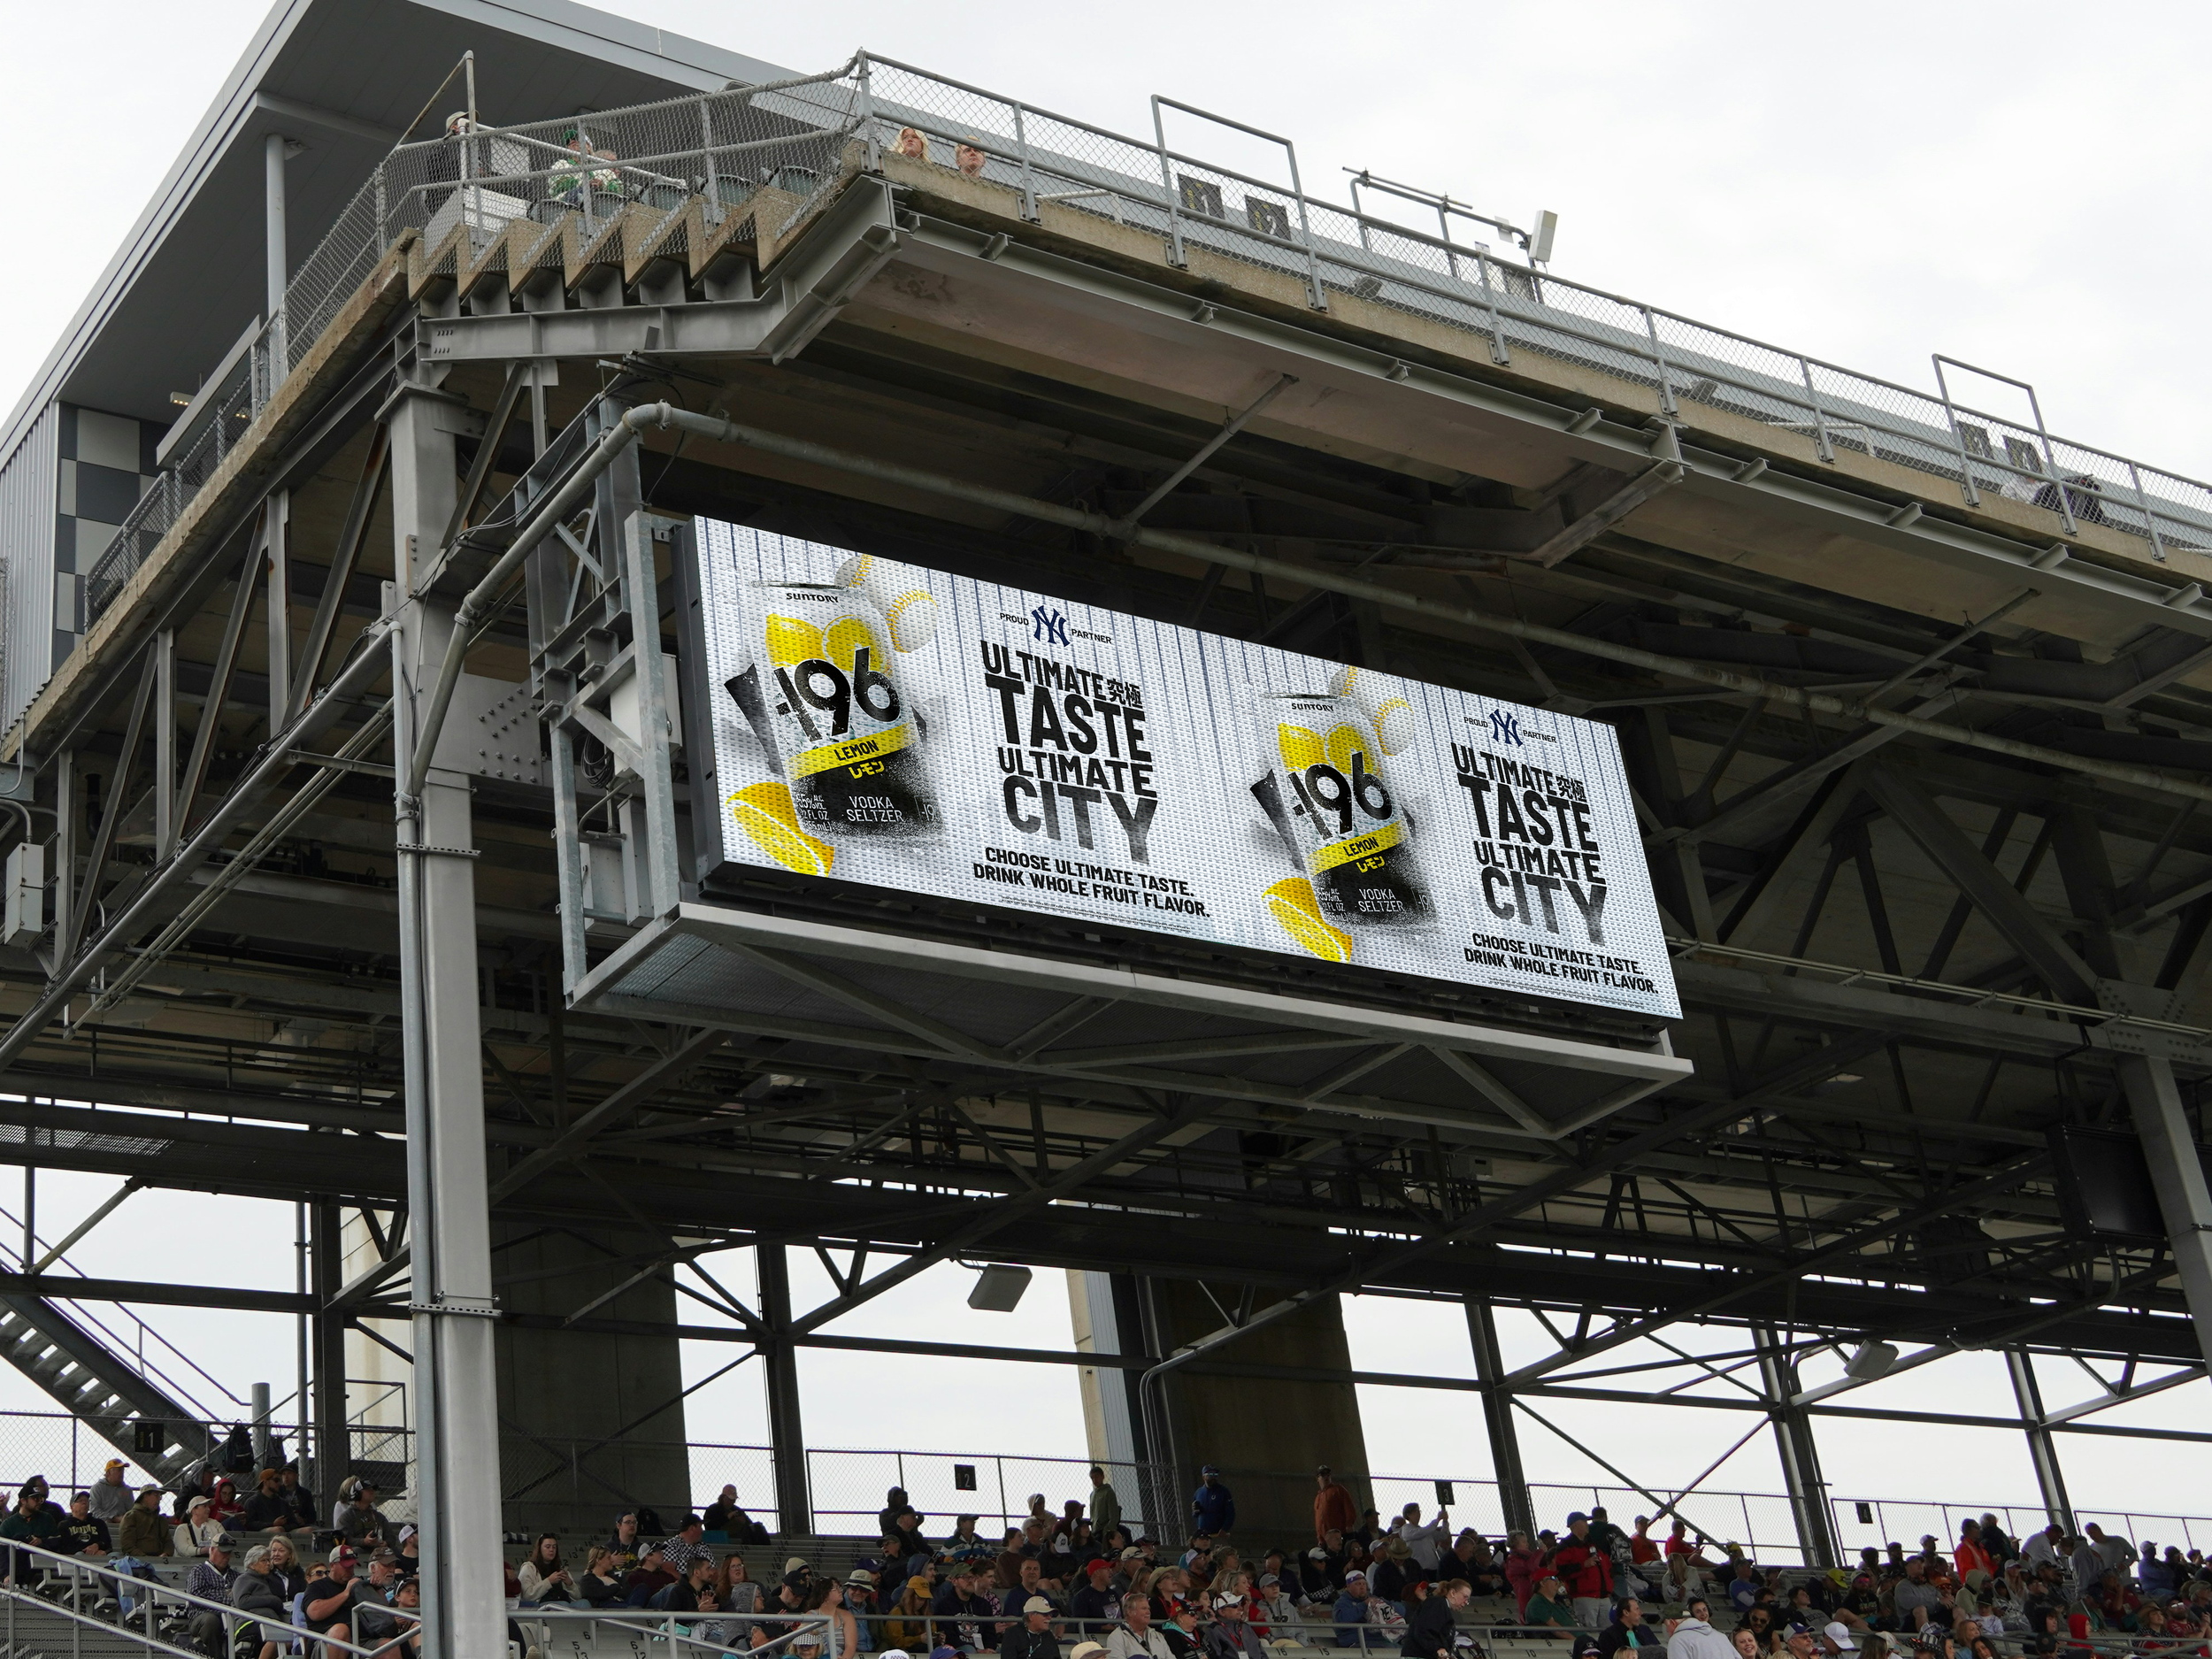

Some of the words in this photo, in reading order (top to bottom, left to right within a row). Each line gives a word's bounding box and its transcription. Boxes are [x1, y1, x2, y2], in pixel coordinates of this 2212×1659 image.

[786, 592, 839, 603] SUNTORY
[1000, 612, 1029, 626] PROUD
[1071, 629, 1112, 644] PARTNER
[980, 640, 1106, 699] ULTIMATE
[1107, 679, 1142, 709] 究極
[773, 646, 901, 742] -196
[1291, 703, 1334, 711] SUNTORY
[985, 672, 1152, 763] TASTE
[1463, 716, 1488, 728] PROUD
[1523, 730, 1556, 743] PARTNER
[833, 740, 879, 761] LEMON
[849, 760, 885, 780] レモン
[997, 747, 1157, 798] ULTIMATE
[1451, 741, 1557, 796] ULTIMATE
[1555, 775, 1587, 803] 究極
[849, 795, 895, 810] VODKA
[1287, 751, 1393, 841] -196
[818, 810, 829, 820] OZ
[846, 810, 904, 822] SELTZER
[1003, 775, 1158, 864] CITY
[1456, 772, 1600, 852] TASTE
[1343, 836, 1379, 857] LEMON
[985, 847, 1052, 872] CHOOSE
[1056, 859, 1135, 887] ULTIMATE
[1138, 874, 1194, 897] TASTE.
[1473, 841, 1607, 885] ULTIMATE
[974, 863, 1025, 886] DRINK
[1029, 872, 1089, 897] WHOLE
[1093, 885, 1139, 904] FRUIT
[1143, 892, 1210, 918] FLAVOR.
[1358, 888, 1397, 901] VODKA
[1336, 902, 1345, 911] OZ
[1357, 901, 1405, 912] SELTZER
[1480, 866, 1607, 947] CITY
[1472, 933, 1527, 955] CHOOSE
[1529, 942, 1594, 967] ULTIMATE
[1596, 955, 1644, 975] TASTE.
[1463, 948, 1507, 968] DRINK
[1509, 956, 1560, 977] WHOLE
[1562, 964, 1600, 984] FRUIT
[1603, 972, 1659, 995] FLAVOR.
[149, 1432, 154, 1448] 1
[964, 1473, 972, 1487] 2
[1443, 1488, 1450, 1502] 3
